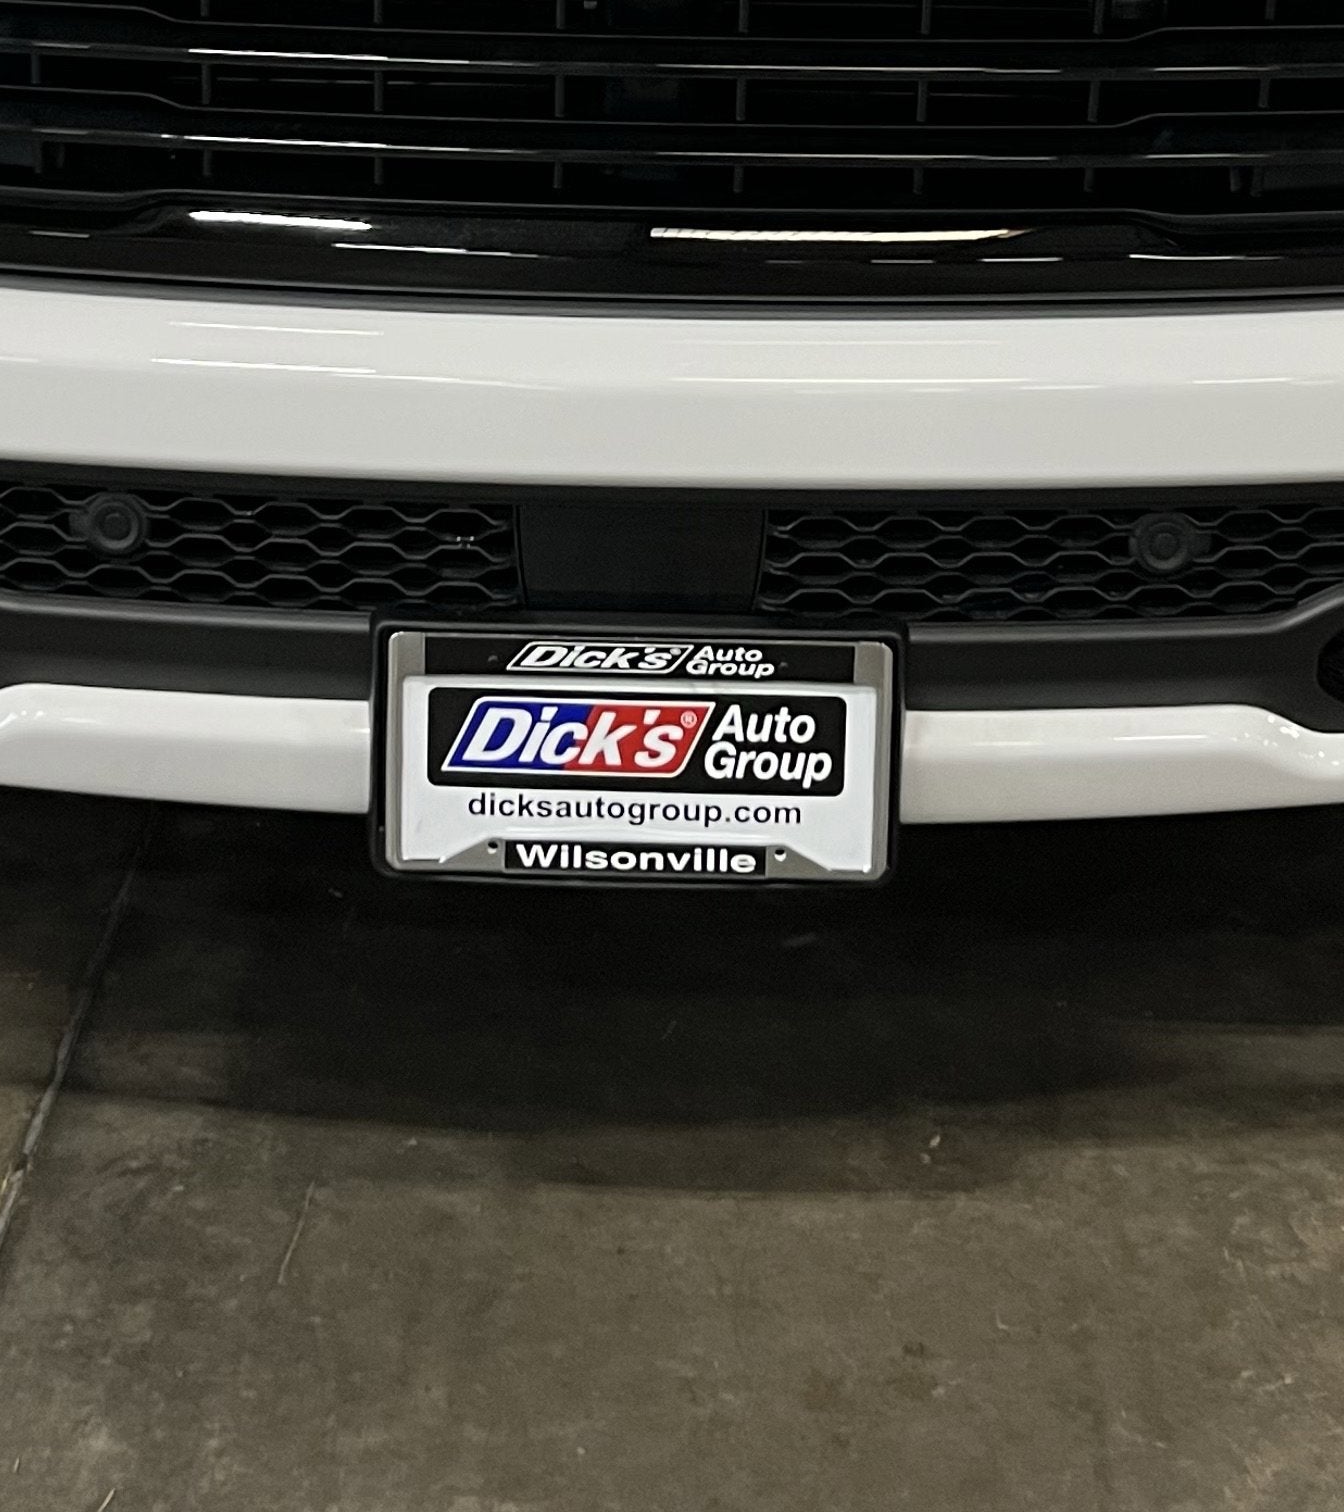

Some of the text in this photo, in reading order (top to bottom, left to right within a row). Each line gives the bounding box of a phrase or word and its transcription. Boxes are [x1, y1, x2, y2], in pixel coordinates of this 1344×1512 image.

[520, 644, 764, 670] Dick's Auto
[686, 659, 776, 679] Group
[461, 704, 816, 768] Dick's Auto
[704, 742, 833, 789] Group
[467, 792, 803, 828] dicksautogroup.com
[515, 844, 758, 874] Wilsonville
